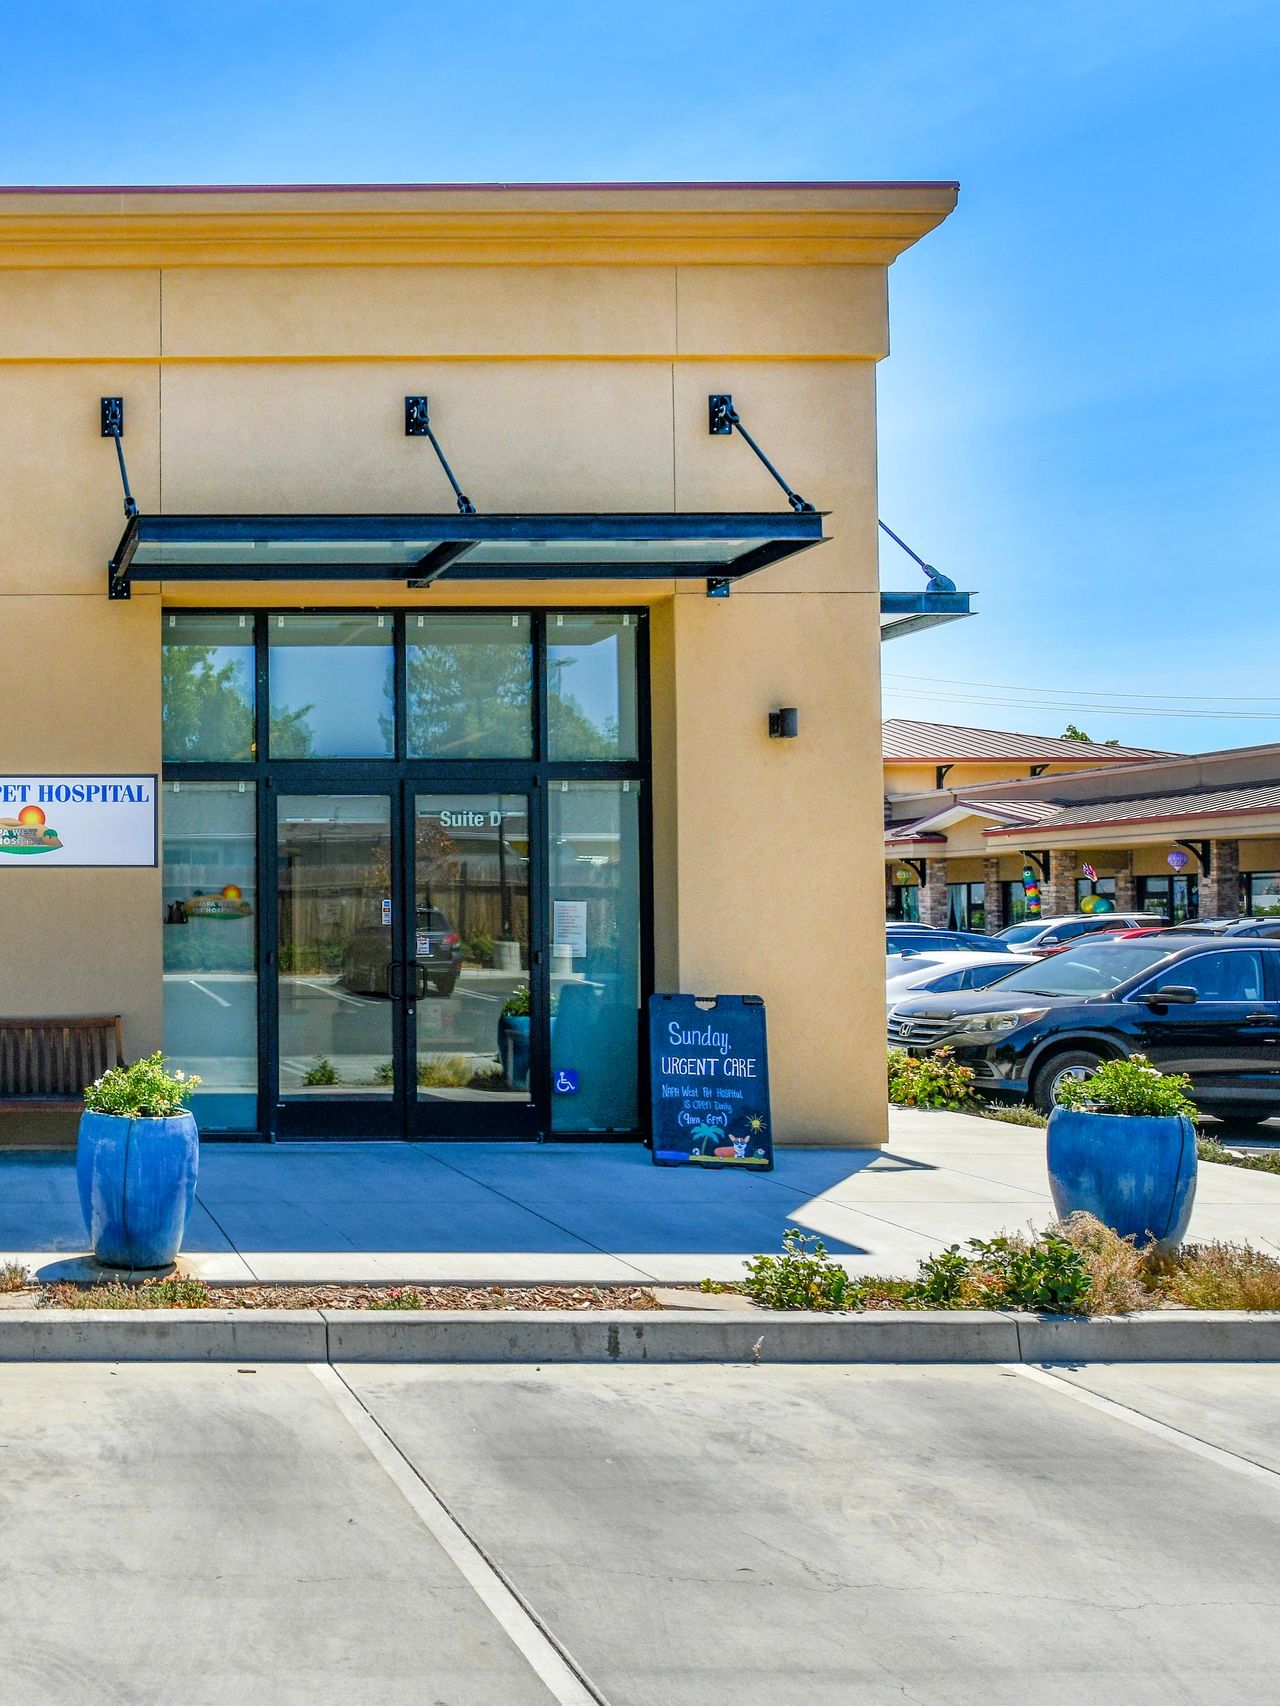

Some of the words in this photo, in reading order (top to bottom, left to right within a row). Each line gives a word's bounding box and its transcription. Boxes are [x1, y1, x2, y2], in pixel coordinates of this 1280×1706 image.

[38, 784, 149, 803] HOSPITAL
[440, 810, 485, 827] Suite
[489, 810, 502, 827] D
[668, 1021, 732, 1055] Sunday,
[661, 1056, 720, 1075] URGENT
[723, 1058, 757, 1078] CARE
